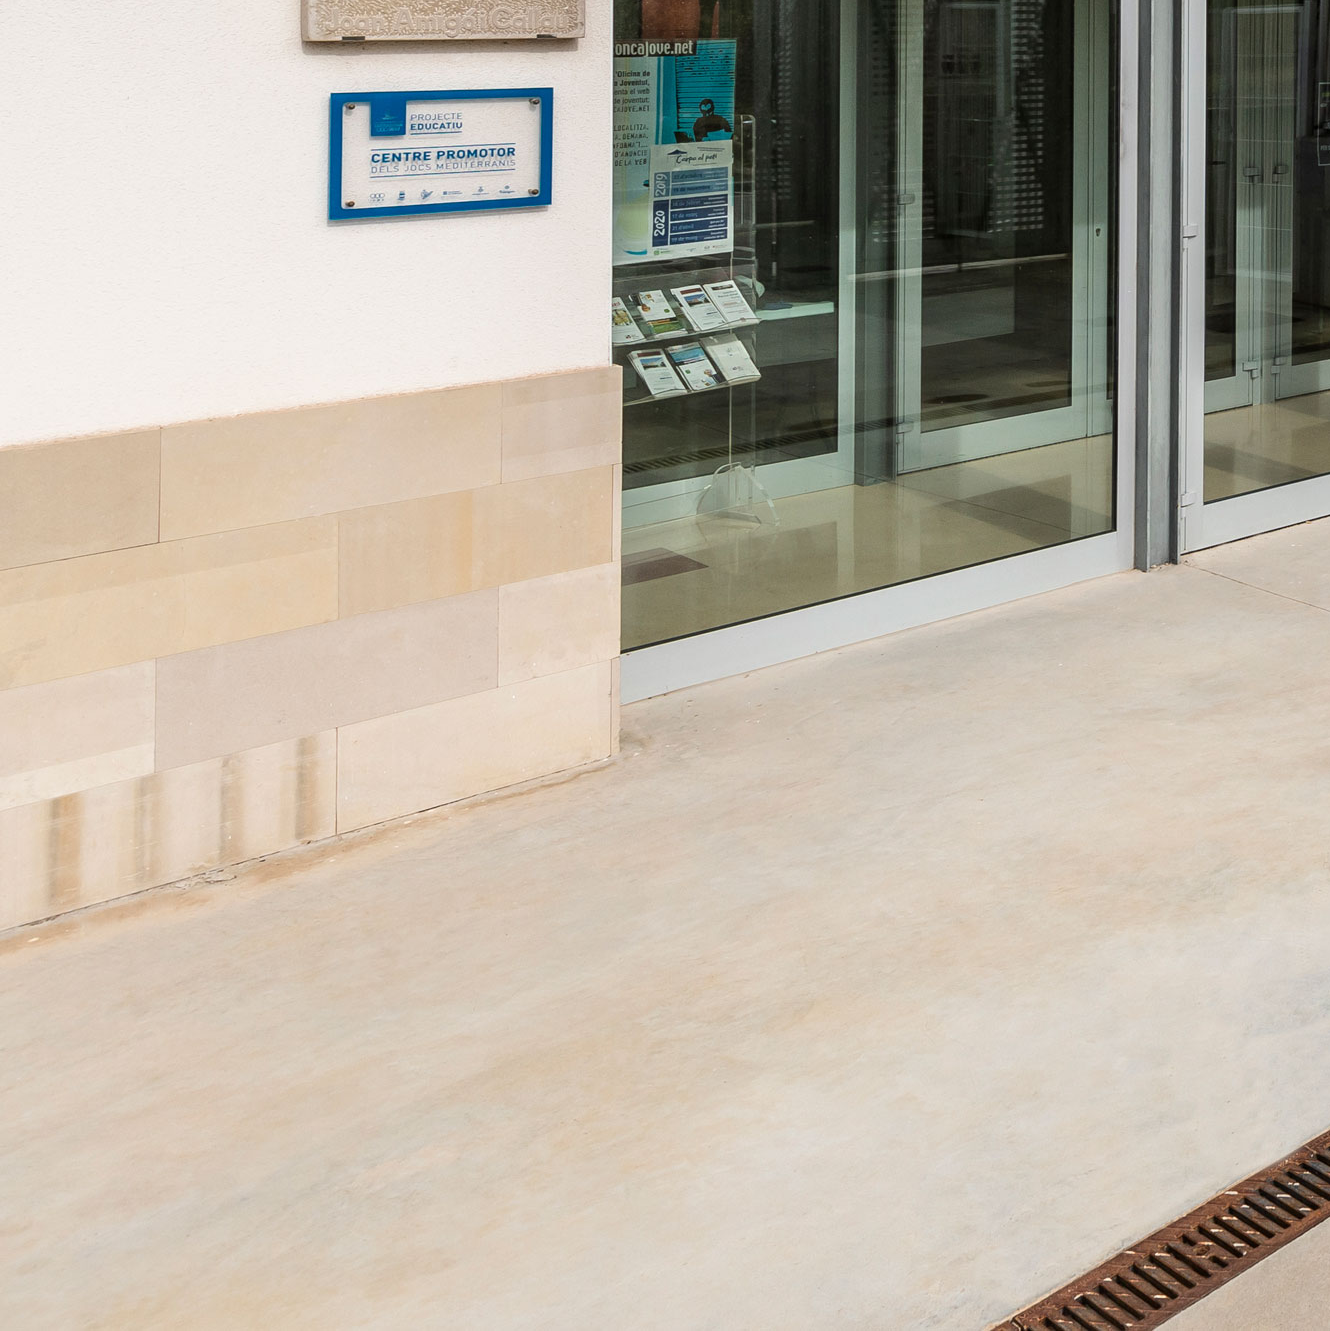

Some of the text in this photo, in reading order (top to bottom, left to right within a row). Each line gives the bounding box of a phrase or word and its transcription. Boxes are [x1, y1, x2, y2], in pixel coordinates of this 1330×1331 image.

[325, 7, 385, 32] Joan
[490, 5, 570, 31] Callau
[410, 112, 462, 120] PROJECTE
[410, 122, 462, 130] EDUCATIU
[371, 147, 516, 164] CENTRE PROMOTOR
[370, 160, 516, 174] DELS JOCS MEDITERRANIS
[655, 173, 667, 196] 2019
[654, 210, 665, 236] 2020
